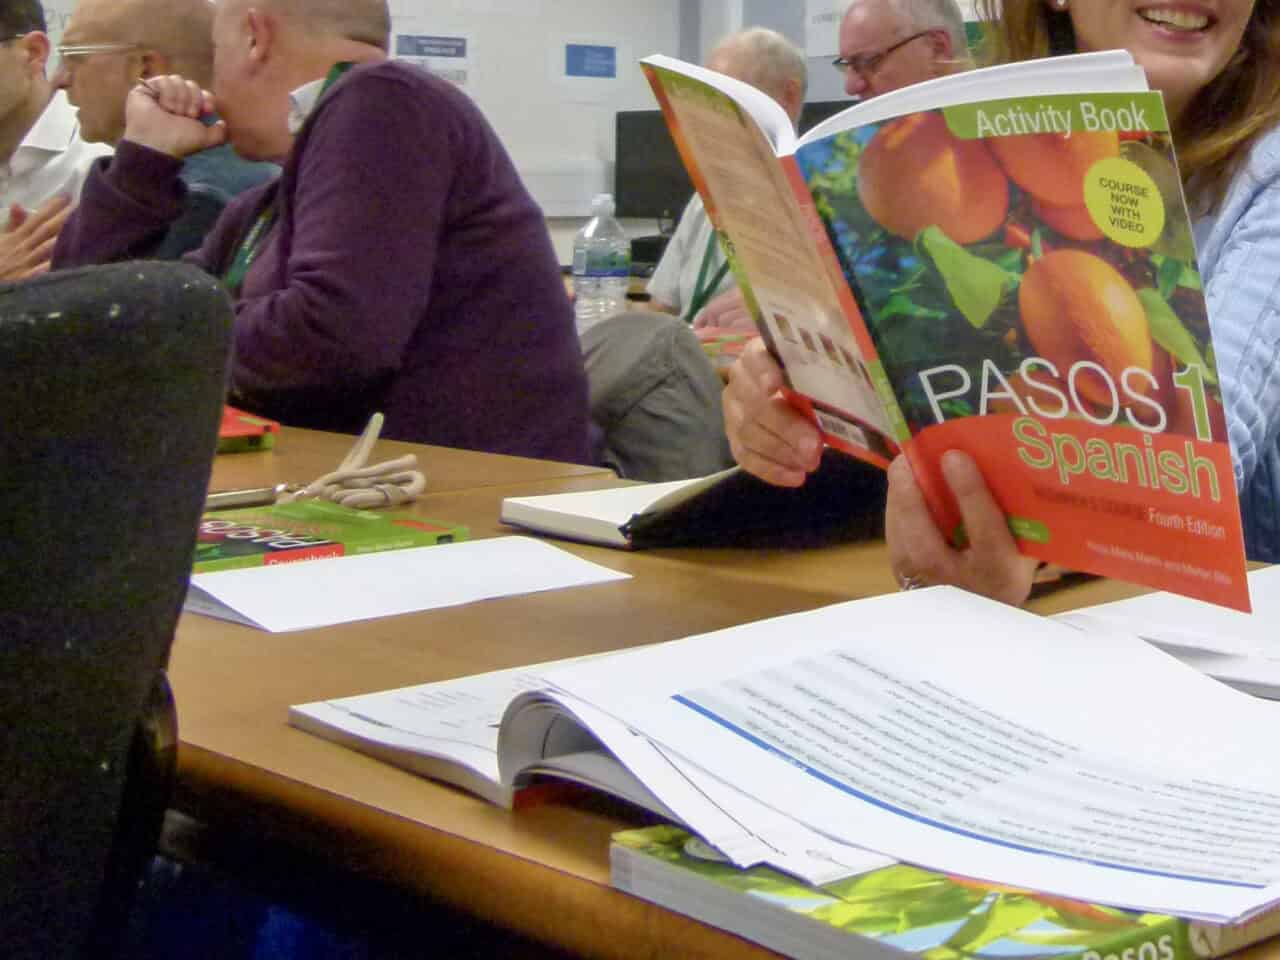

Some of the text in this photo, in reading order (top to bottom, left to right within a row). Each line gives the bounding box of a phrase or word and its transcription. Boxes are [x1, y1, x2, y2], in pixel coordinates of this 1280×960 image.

[975, 100, 1149, 138] Activity Book
[1098, 176, 1150, 199] COURSE
[1110, 191, 1139, 209] NOW
[1107, 215, 1145, 234] VIDEO
[1110, 203, 1141, 221] WITH
[918, 356, 1214, 443] PASOS 1
[1012, 416, 1221, 503] Spanish
[1148, 507, 1226, 539] Fourth Edition
